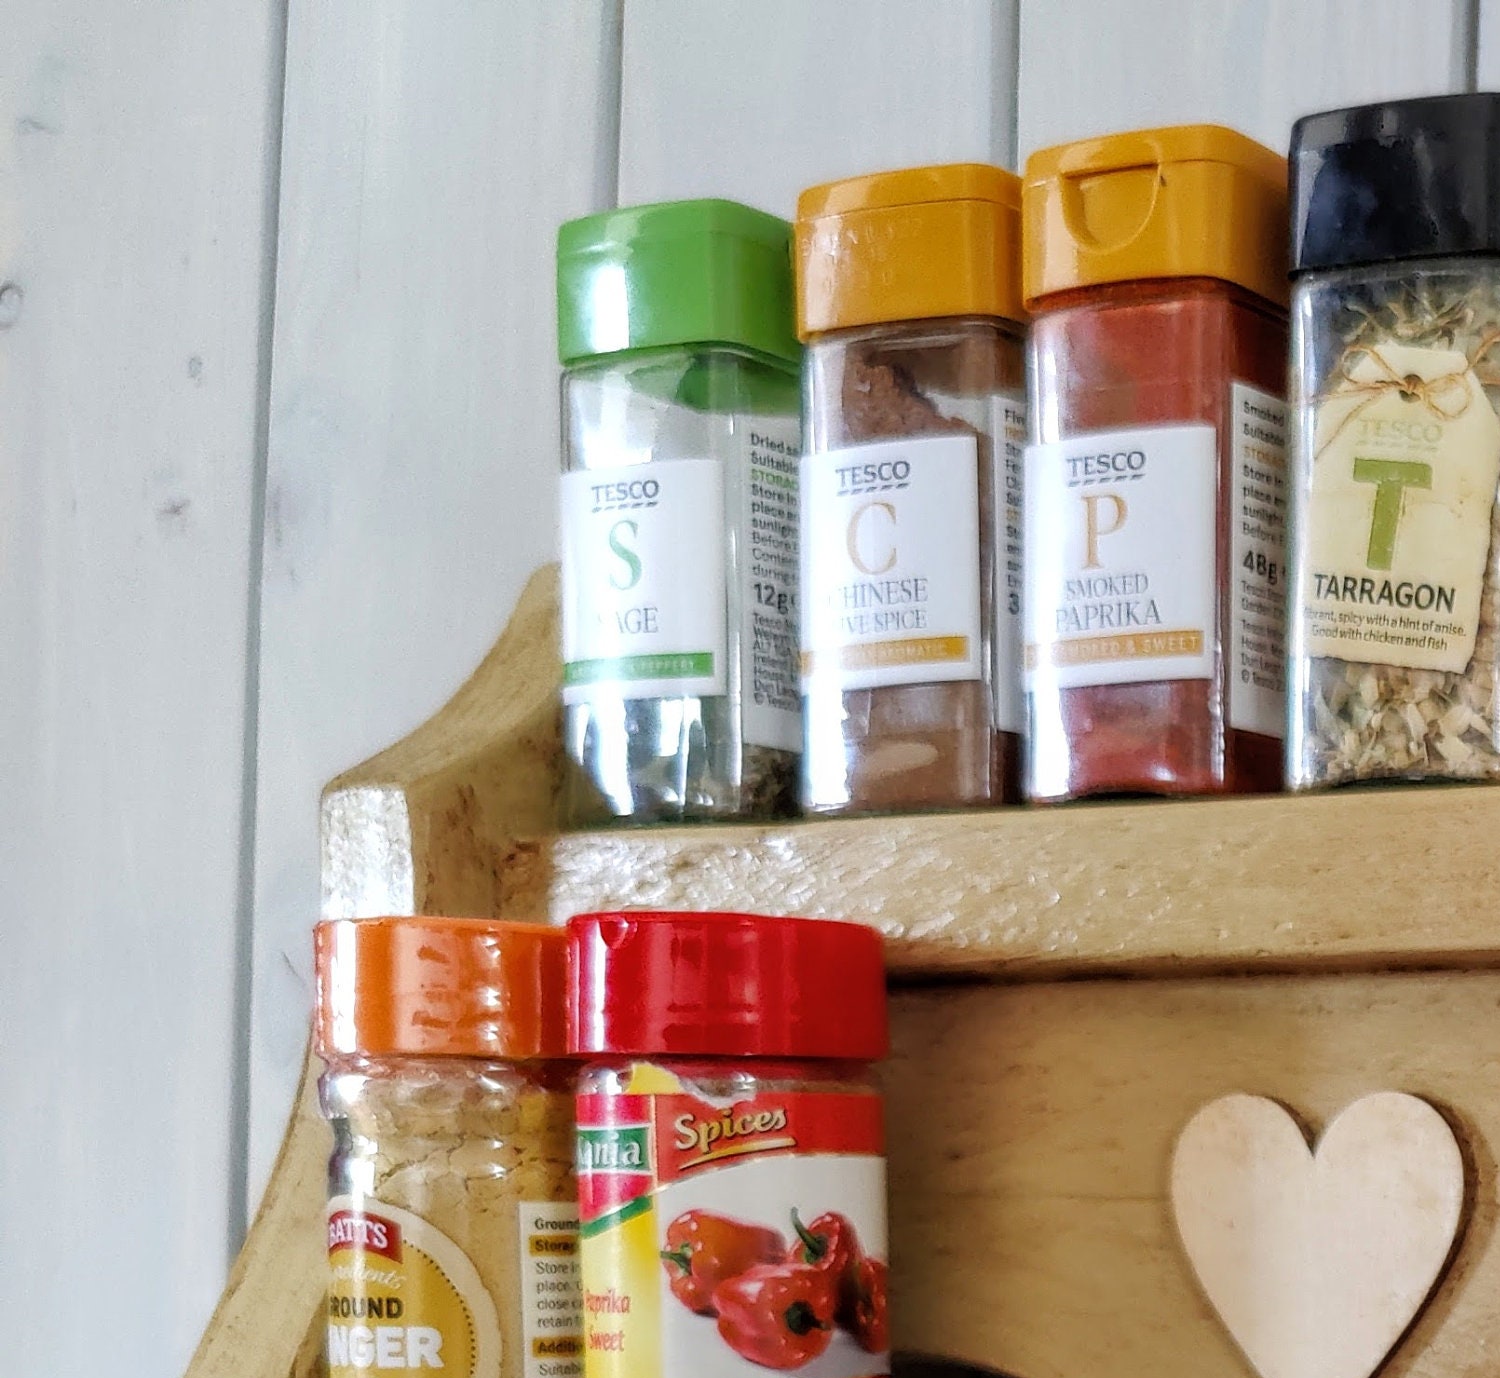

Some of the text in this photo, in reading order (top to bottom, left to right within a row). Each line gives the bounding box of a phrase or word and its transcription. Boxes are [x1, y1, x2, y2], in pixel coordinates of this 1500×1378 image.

[1358, 420, 1443, 442] TESCO
[835, 461, 910, 486] TESCO
[1067, 451, 1146, 478] TESCO
[591, 480, 660, 503] TESCO
[1353, 456, 1433, 571] T
[847, 502, 897, 575] C
[1081, 494, 1127, 570] P
[609, 520, 642, 590] S
[830, 578, 928, 609] HINESE
[1066, 573, 1149, 601] SMOKED
[1314, 573, 1456, 614] TARRAGON
[874, 609, 927, 634] SPICE
[1056, 599, 1162, 632] PAPRIKA
[1338, 611, 1365, 626] spicy
[1366, 613, 1390, 628] with
[1390, 617, 1399, 628] a
[1400, 615, 1421, 631] hint
[1422, 620, 1435, 632] of
[1141, 636, 1198, 654] SWEET
[1311, 624, 1448, 650] Good with chicken and fish
[674, 1107, 787, 1154] Spices
[577, 1131, 641, 1166] ania
[536, 1262, 568, 1274] Store
[330, 1296, 404, 1319] ROUND
[537, 1299, 569, 1310] close
[538, 1316, 573, 1328] retain
[328, 1324, 444, 1369] NGER
